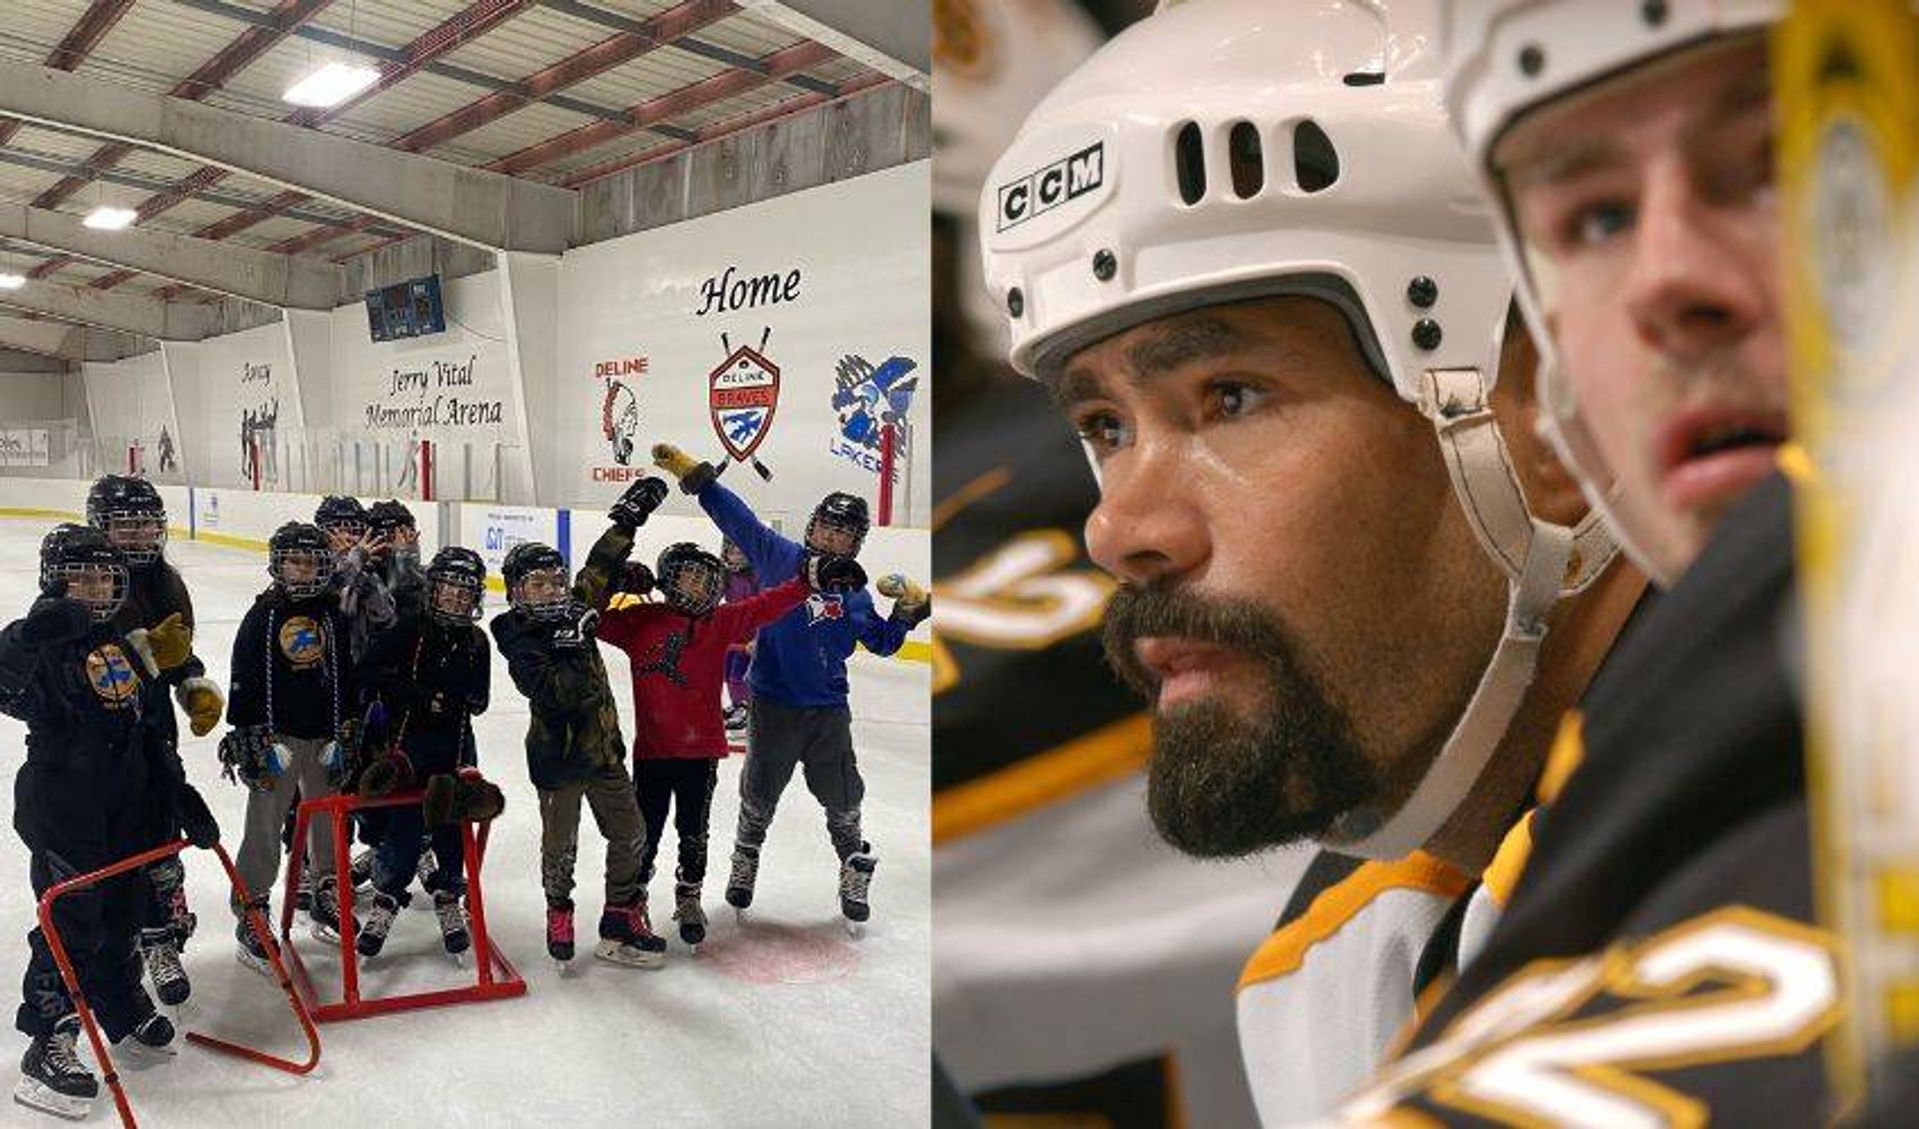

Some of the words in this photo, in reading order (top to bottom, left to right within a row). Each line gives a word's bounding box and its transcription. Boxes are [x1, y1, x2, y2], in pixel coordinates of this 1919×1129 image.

[1003, 147, 1102, 221] CCM
[696, 266, 801, 315] Home
[390, 369, 429, 399] Jerry
[432, 354, 477, 387] Vital
[596, 357, 648, 378] DELINE
[722, 371, 765, 383] DELINE
[365, 395, 443, 429] Memorial
[443, 397, 503, 425] Arena
[717, 389, 769, 405] BRAVES
